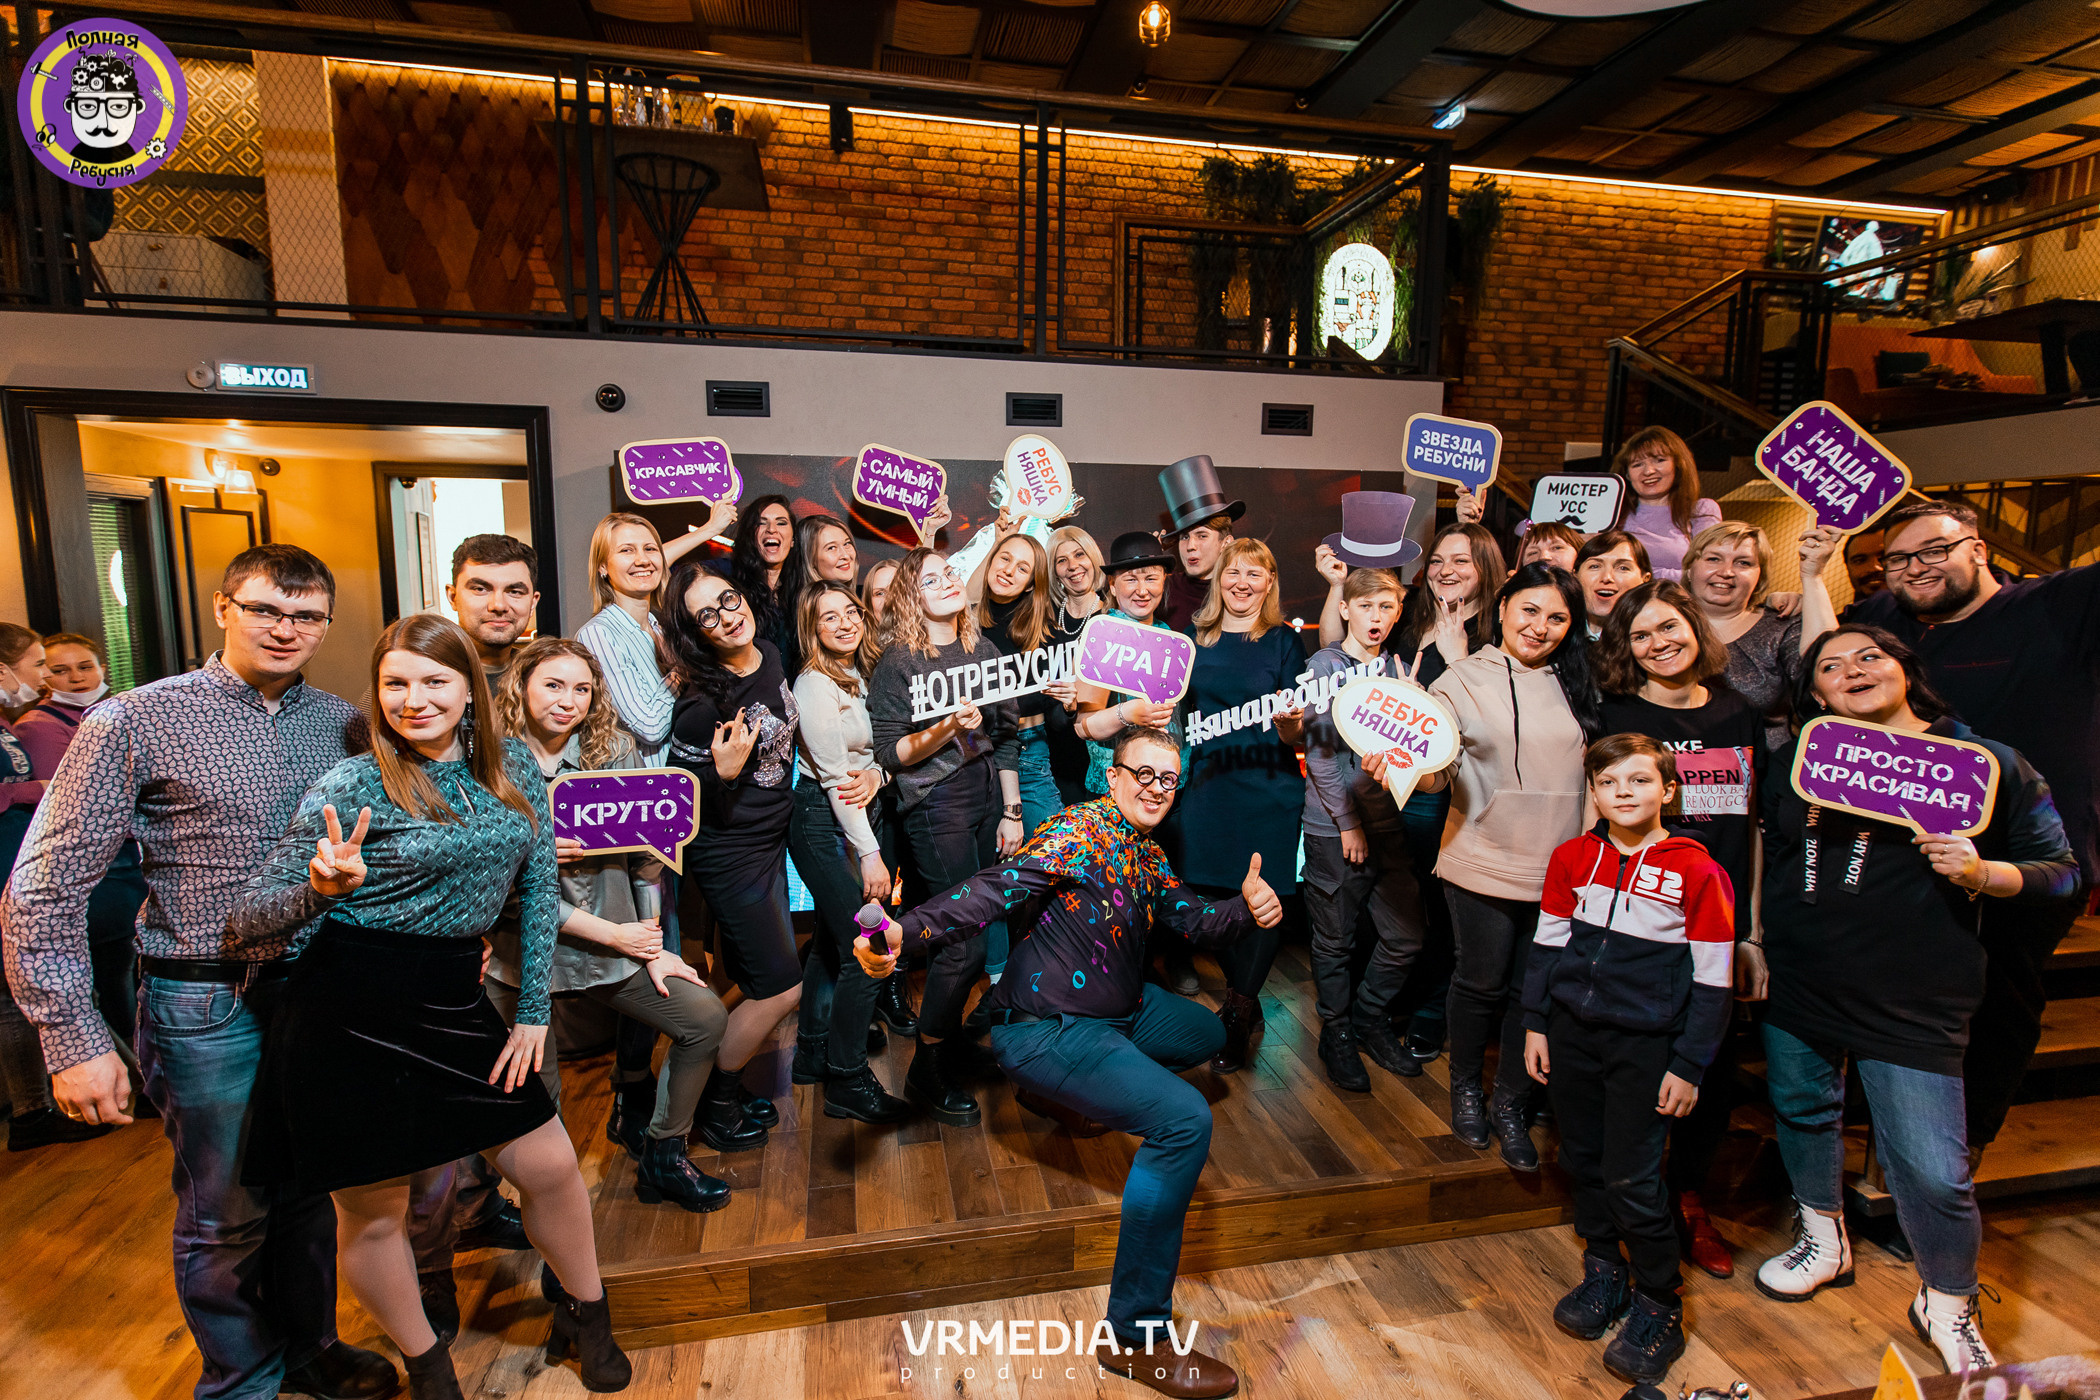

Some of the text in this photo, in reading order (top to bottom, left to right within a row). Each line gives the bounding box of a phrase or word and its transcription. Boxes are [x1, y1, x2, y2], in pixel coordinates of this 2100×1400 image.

[223, 365, 308, 389] ВЫХОД
[1420, 429, 1484, 456] ЗВЕЗДА
[634, 461, 722, 480] КРАСАВЧИК
[869, 458, 935, 491] САМЫЙ
[1032, 447, 1063, 497] РЕБУС
[1413, 445, 1487, 474] РЕБУСНИ
[1805, 428, 1877, 495] НАША
[866, 477, 929, 509] УМНЫЙ
[1017, 451, 1050, 507] НЯШКА
[1547, 482, 1609, 498] МИСТЕР
[1780, 443, 1860, 516] БАНДА
[1559, 500, 1588, 514] УСС
[1365, 688, 1439, 736] РЕБУС
[1351, 704, 1431, 758] НЯШКА
[1835, 742, 1955, 782] ПРОСТО
[1810, 761, 1972, 812] КРАСИВАЯ
[574, 799, 678, 827] КРУТО
[1853, 831, 1871, 857] WHY
[1634, 864, 1683, 899] 52
[1804, 866, 1817, 892] WHY
